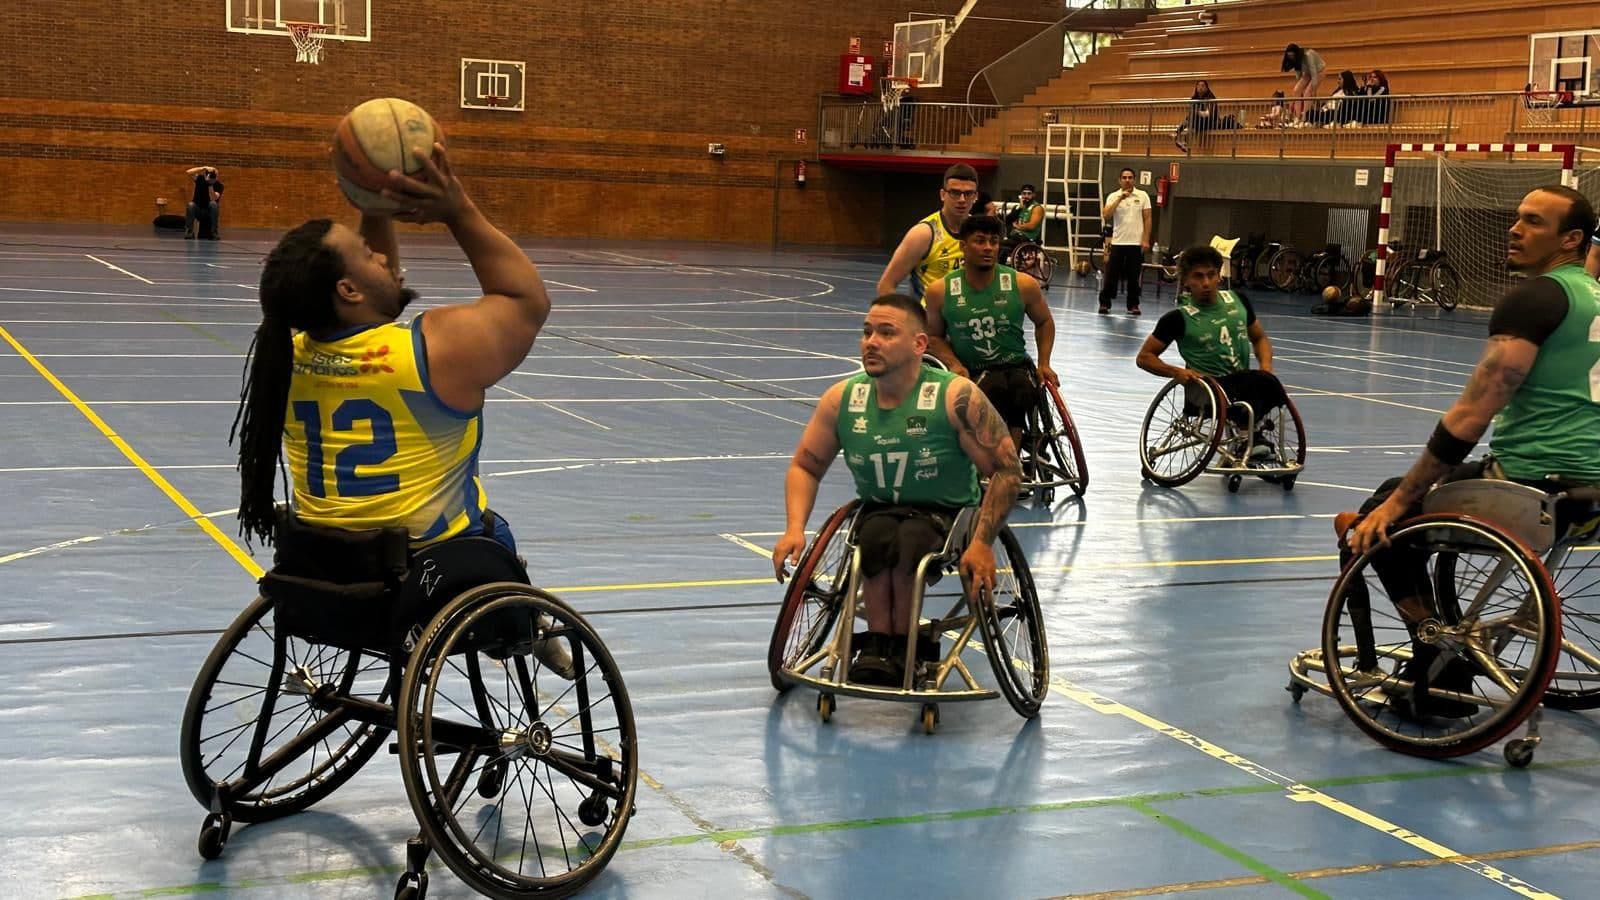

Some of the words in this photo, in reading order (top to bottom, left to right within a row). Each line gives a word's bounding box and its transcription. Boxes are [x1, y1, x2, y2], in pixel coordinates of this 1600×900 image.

[969, 316, 996, 340] 33
[1220, 326, 1232, 346] 4
[292, 398, 400, 498] 12
[869, 452, 909, 488] 17
